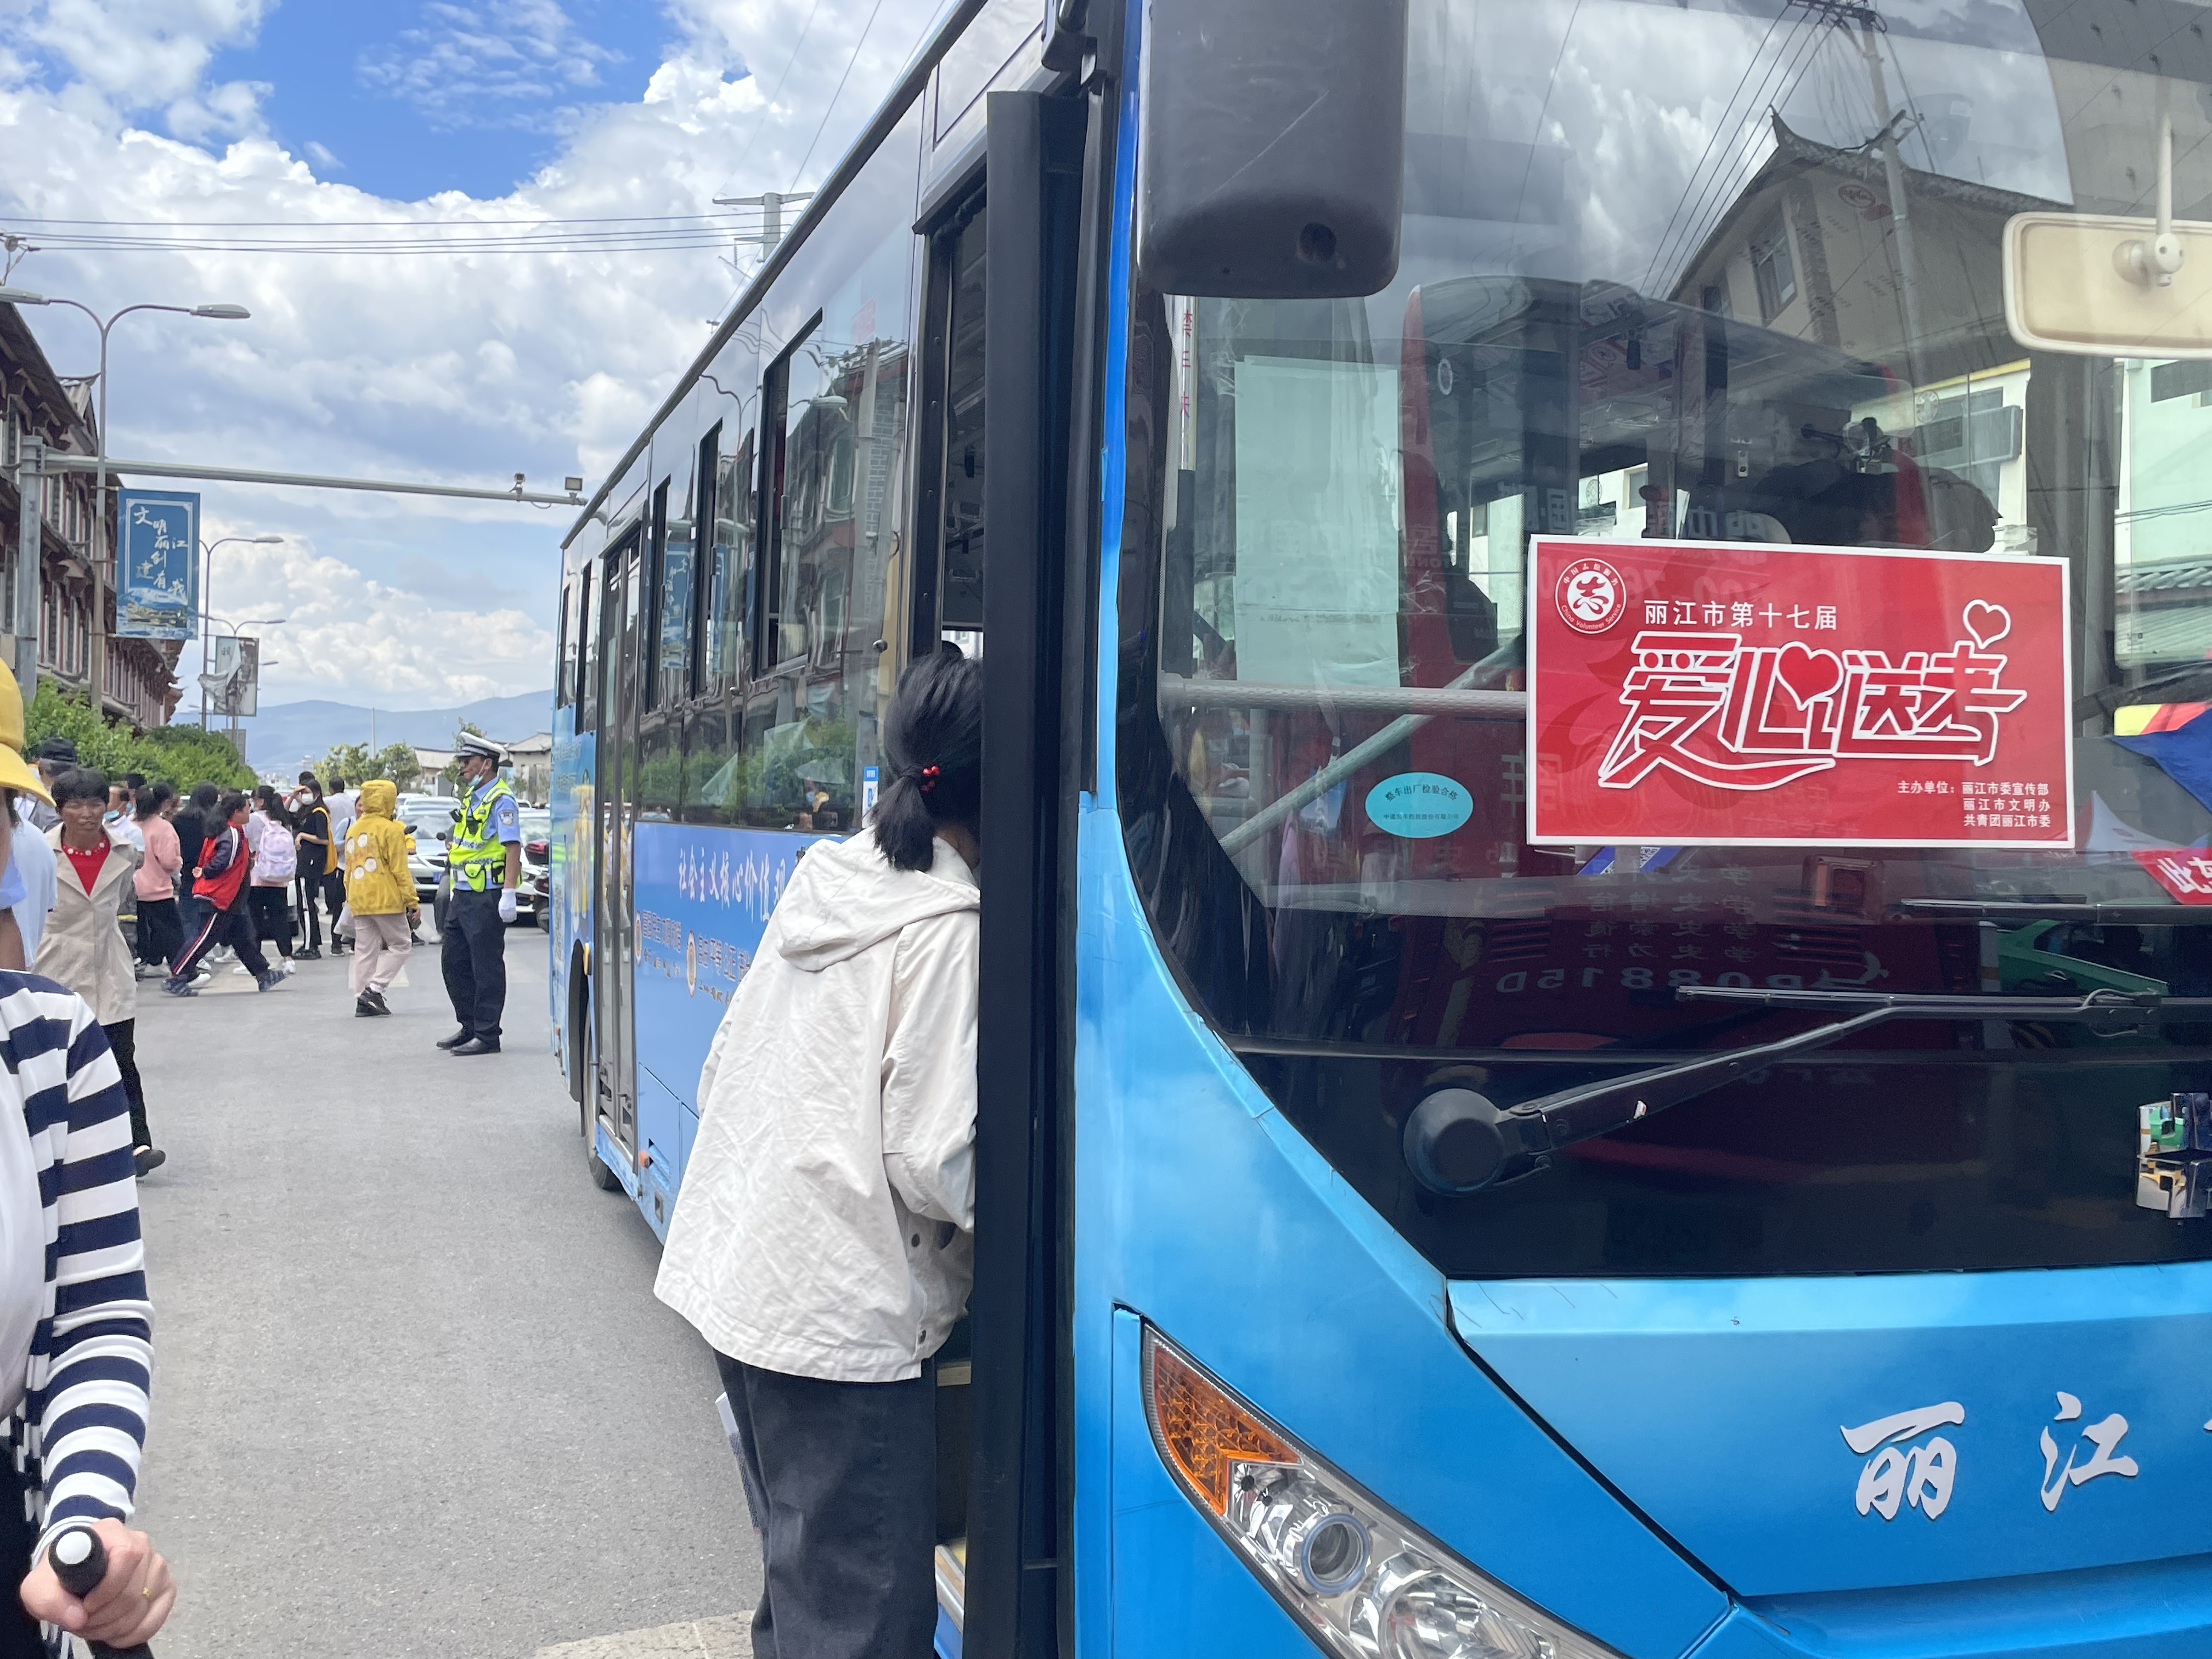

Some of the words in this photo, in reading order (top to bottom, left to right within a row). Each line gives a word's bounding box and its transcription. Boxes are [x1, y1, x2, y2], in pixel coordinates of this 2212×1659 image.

[134, 506, 189, 550] 文明丽江
[1561, 605, 1575, 623] China
[1576, 619, 1605, 630] Volunteer
[1605, 603, 1621, 624] Service
[1644, 600, 1838, 631] 丽江市第十七届
[1598, 630, 2028, 791] 爱心送考
[1897, 780, 1955, 794] 主办单位：
[1961, 781, 2049, 795] 丽江市委宣传部
[1963, 798, 2051, 812] 丽江市文明办
[1963, 814, 2051, 828] 共青团丽江市委
[1840, 1391, 2212, 1520] 丽江
